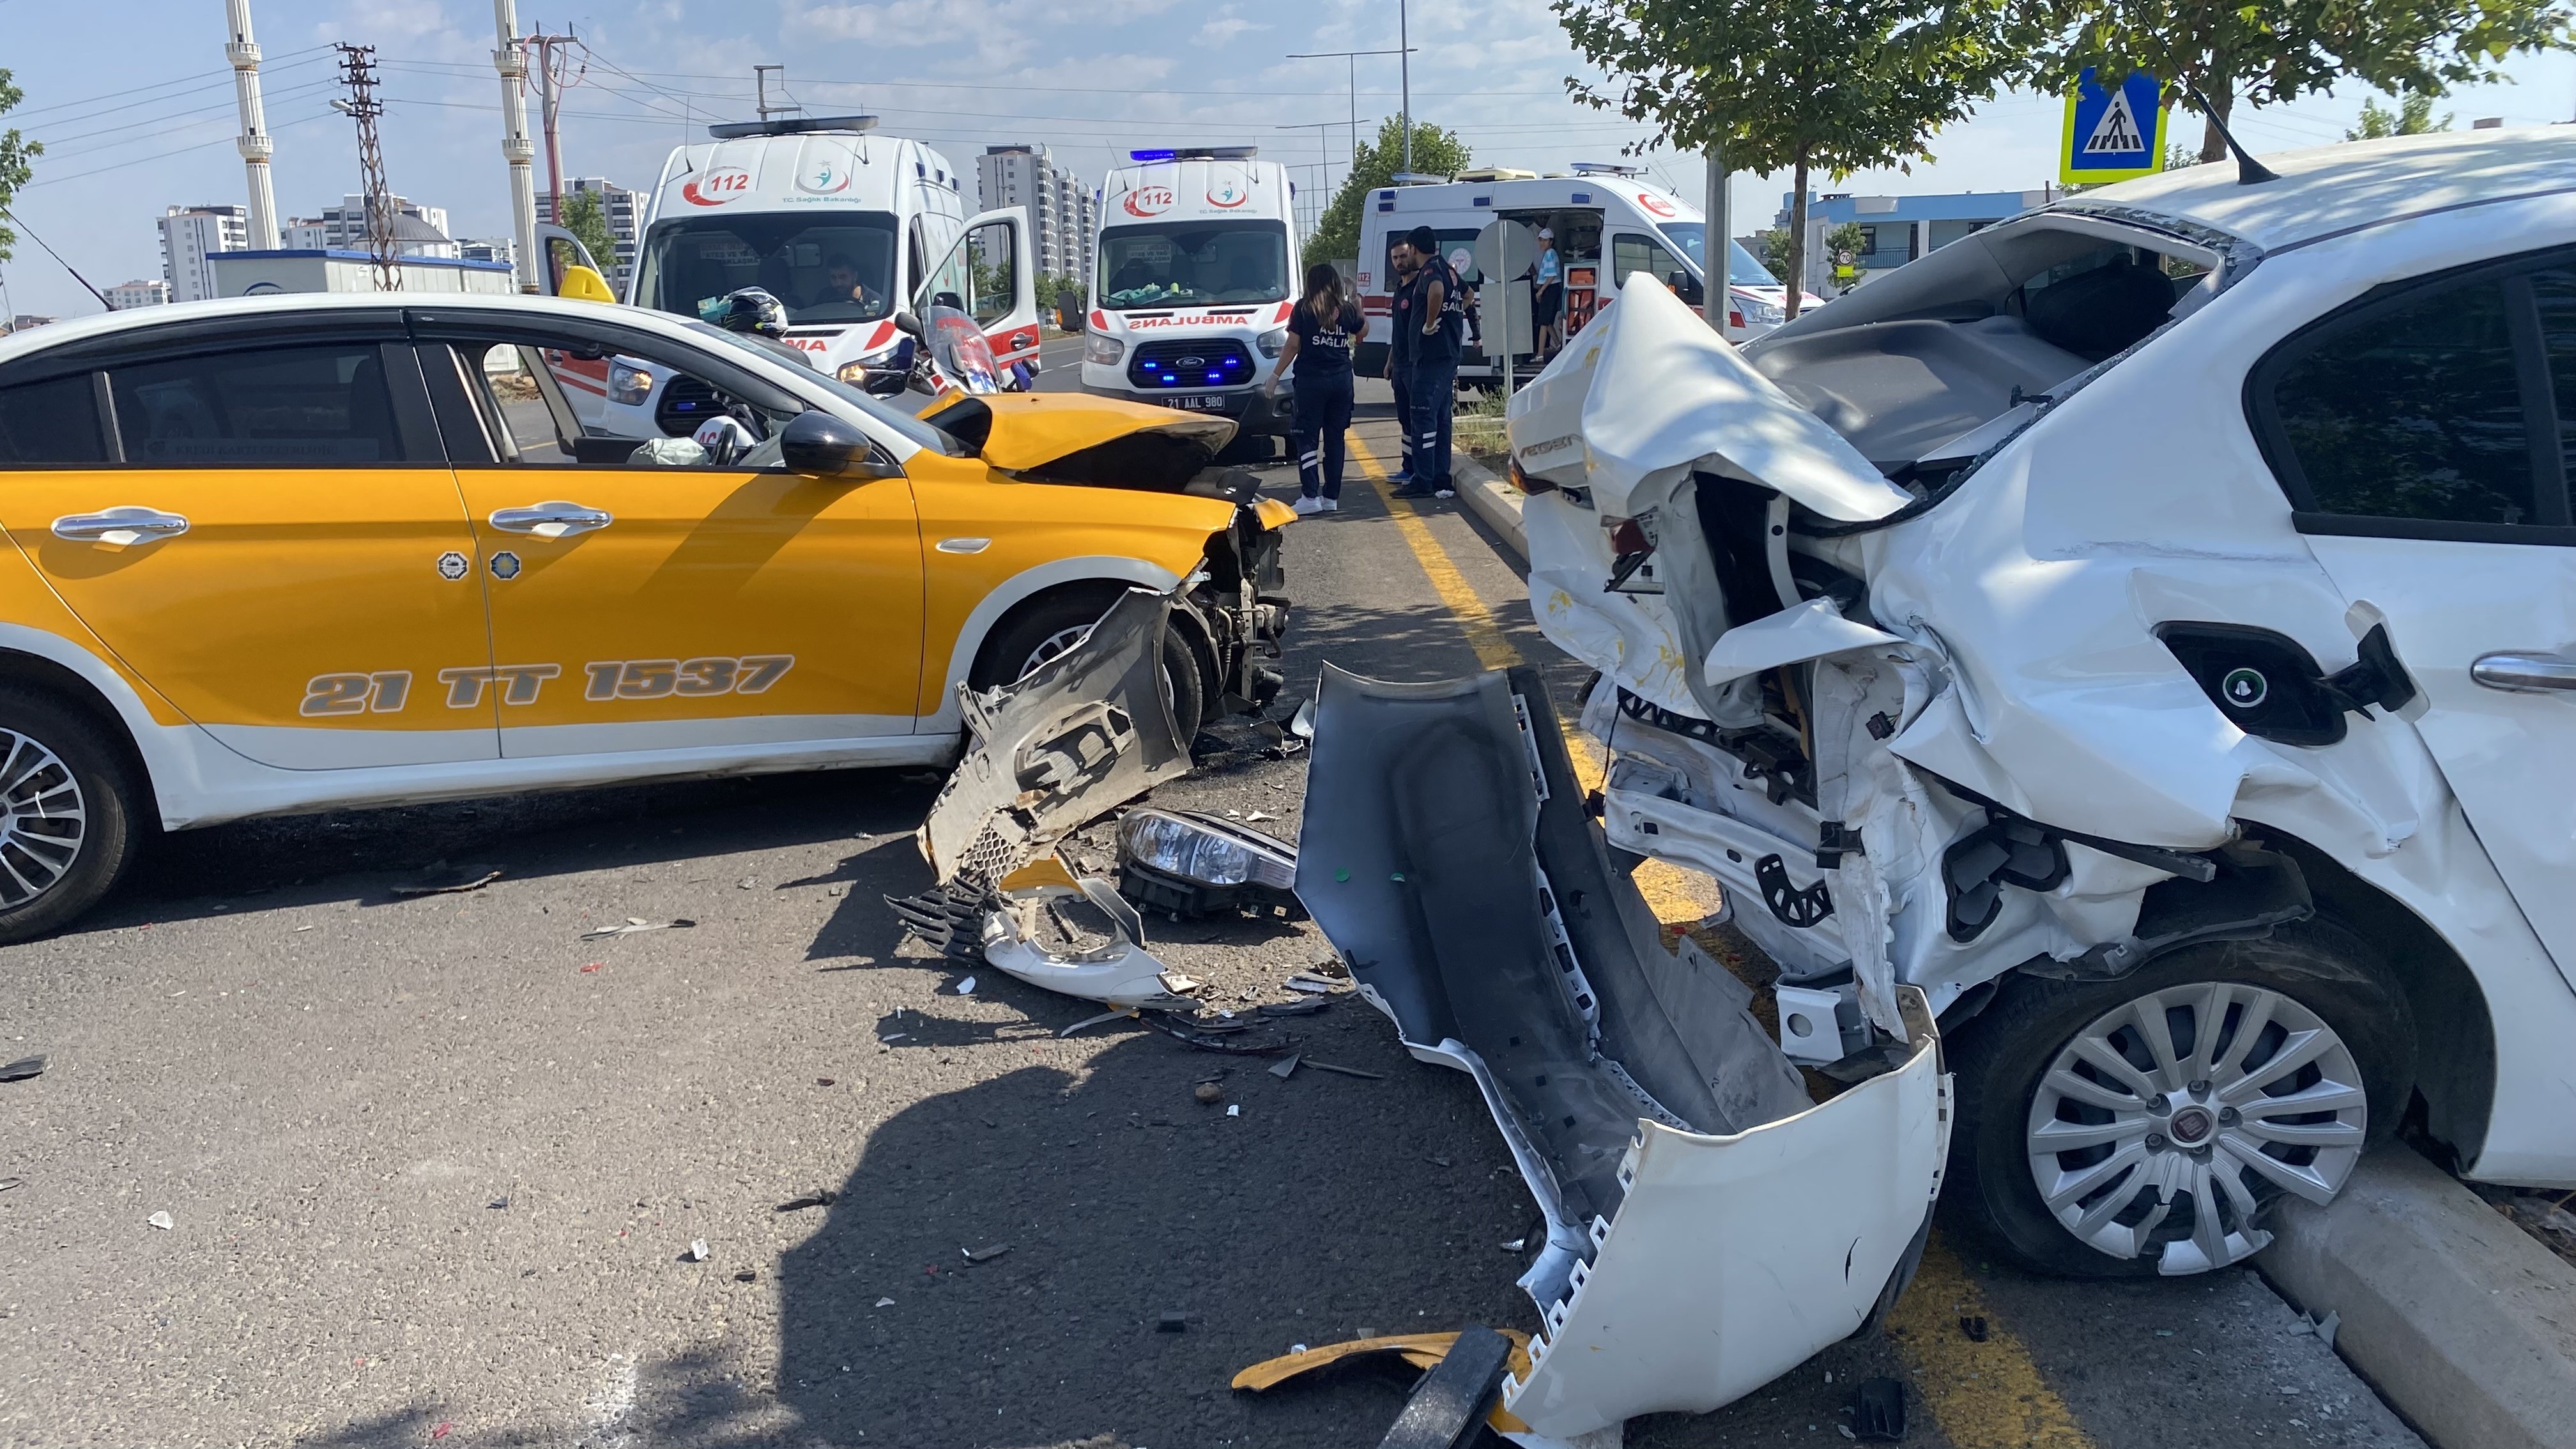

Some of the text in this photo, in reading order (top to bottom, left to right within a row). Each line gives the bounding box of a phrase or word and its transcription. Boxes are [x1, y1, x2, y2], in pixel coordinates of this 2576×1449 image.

[711, 174, 749, 191] 112
[1144, 192, 1172, 205] 112
[1168, 397, 1222, 408] 21 AAL 980
[299, 655, 795, 717] 21 TT 1537
